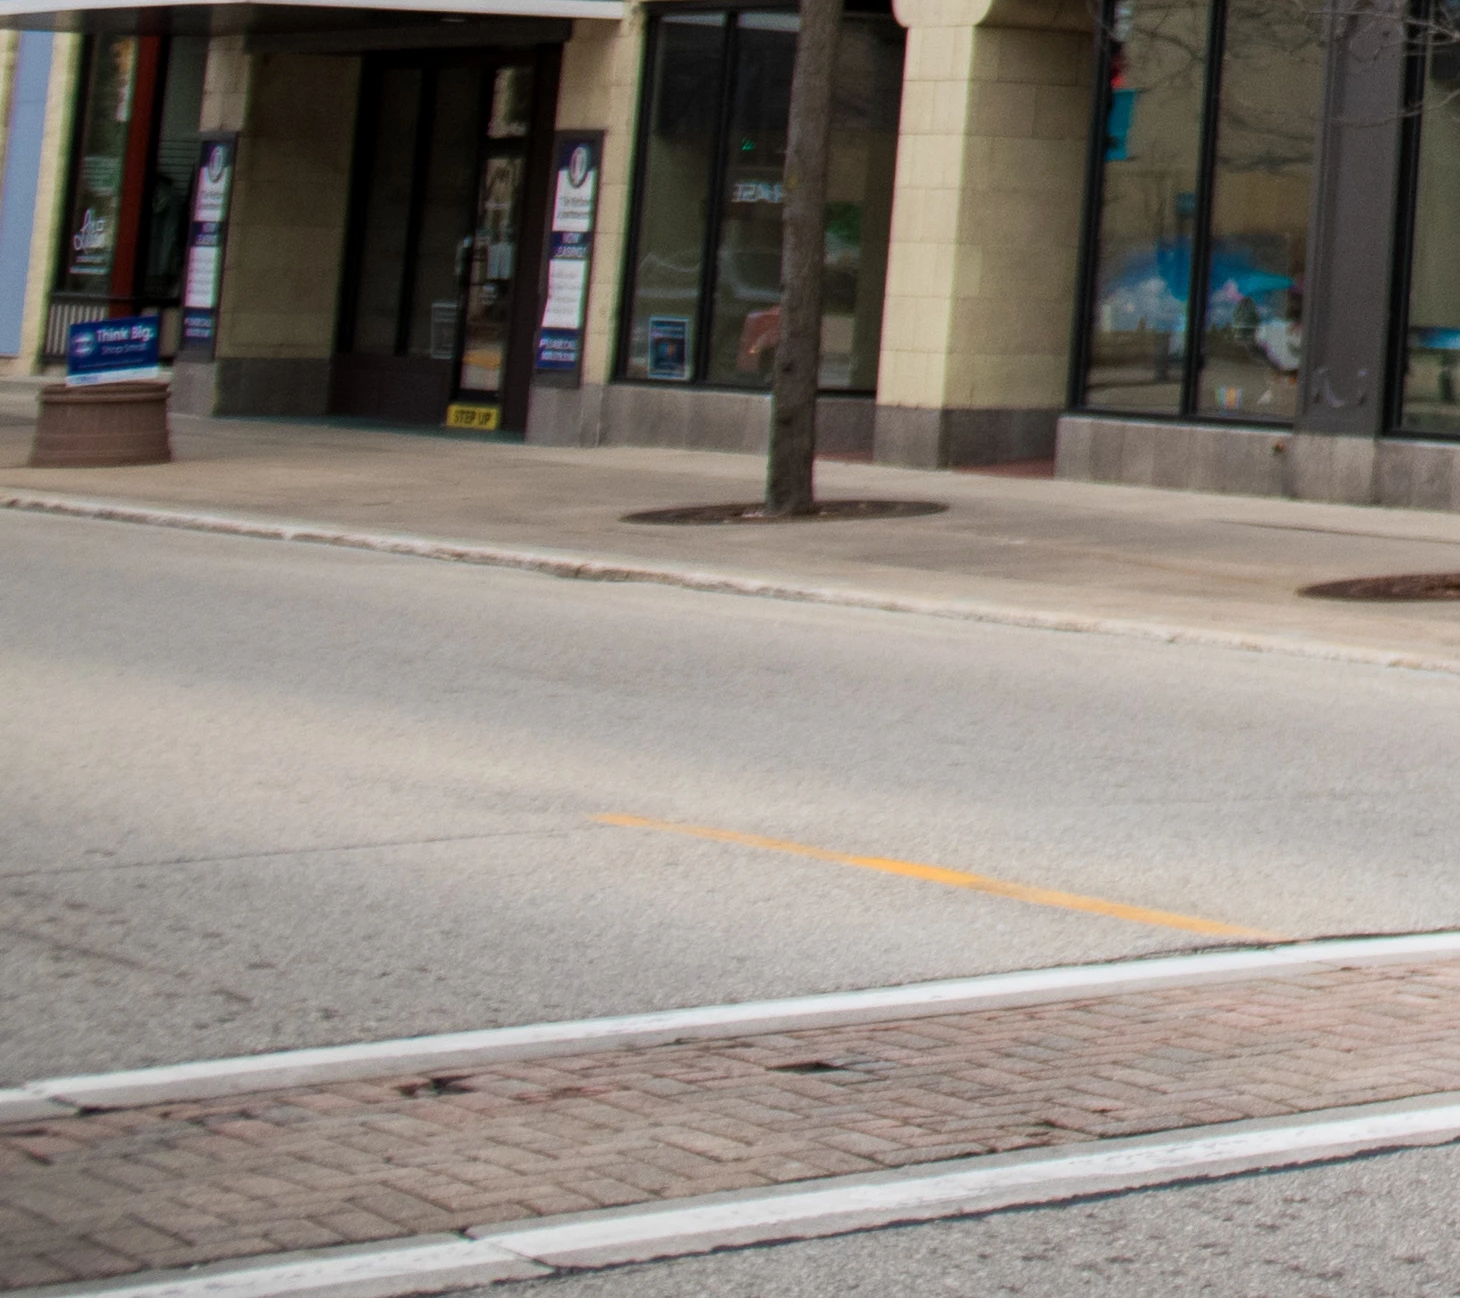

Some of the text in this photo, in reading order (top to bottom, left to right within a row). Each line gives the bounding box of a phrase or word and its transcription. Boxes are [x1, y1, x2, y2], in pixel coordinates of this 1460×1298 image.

[96, 326, 129, 343] Think
[453, 409, 491, 425] STEP UP
